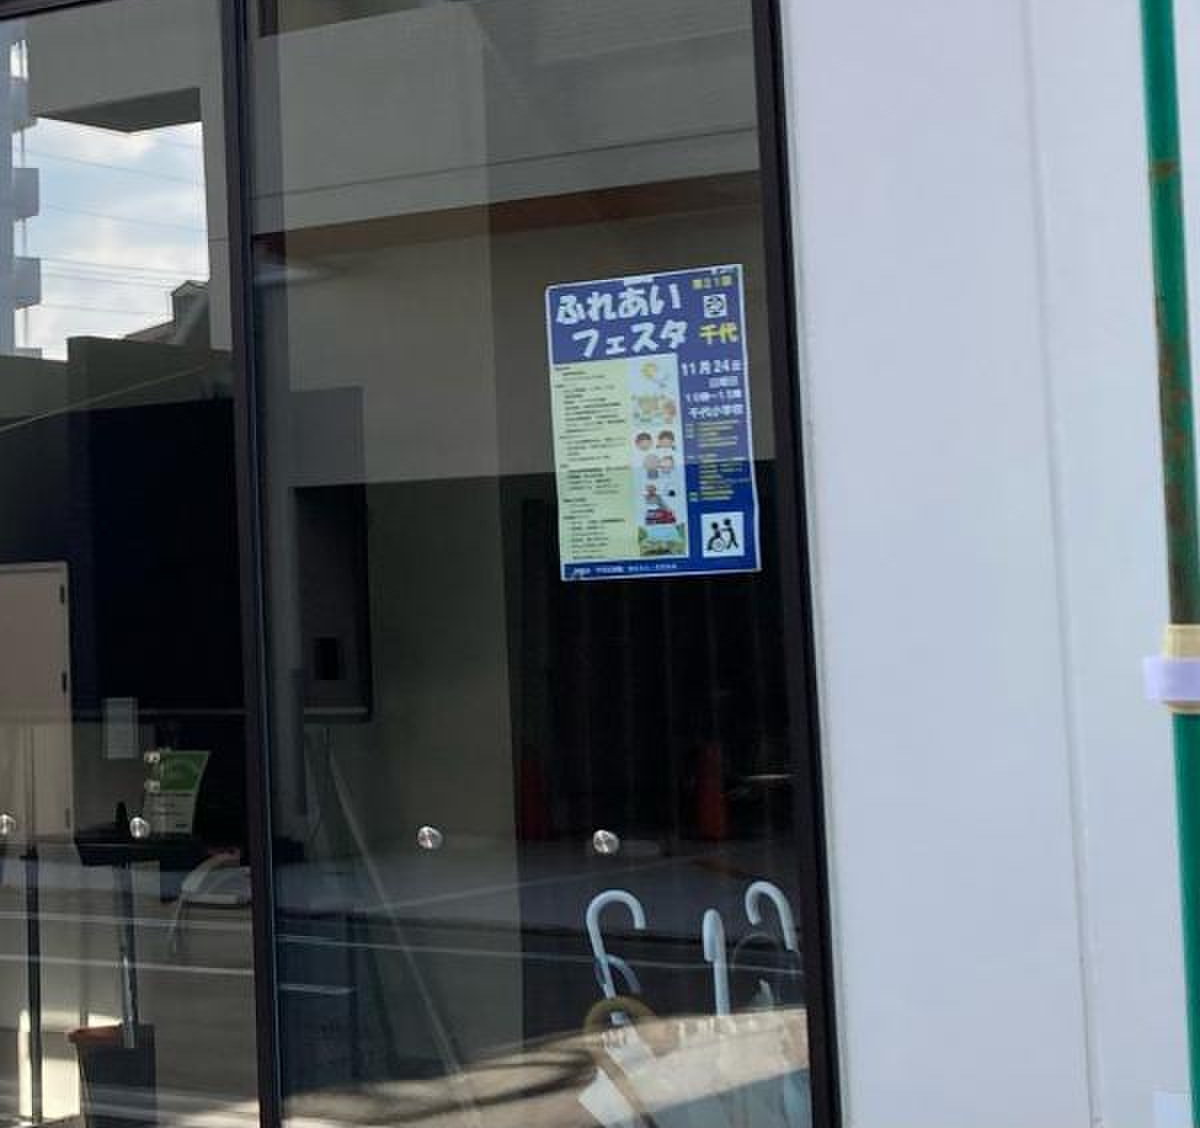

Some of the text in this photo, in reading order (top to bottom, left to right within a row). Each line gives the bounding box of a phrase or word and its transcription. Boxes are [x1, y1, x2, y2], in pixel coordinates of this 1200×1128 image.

[556, 283, 682, 325] ふれあい
[572, 319, 689, 358] フェスタ
[699, 321, 739, 345] 千代
